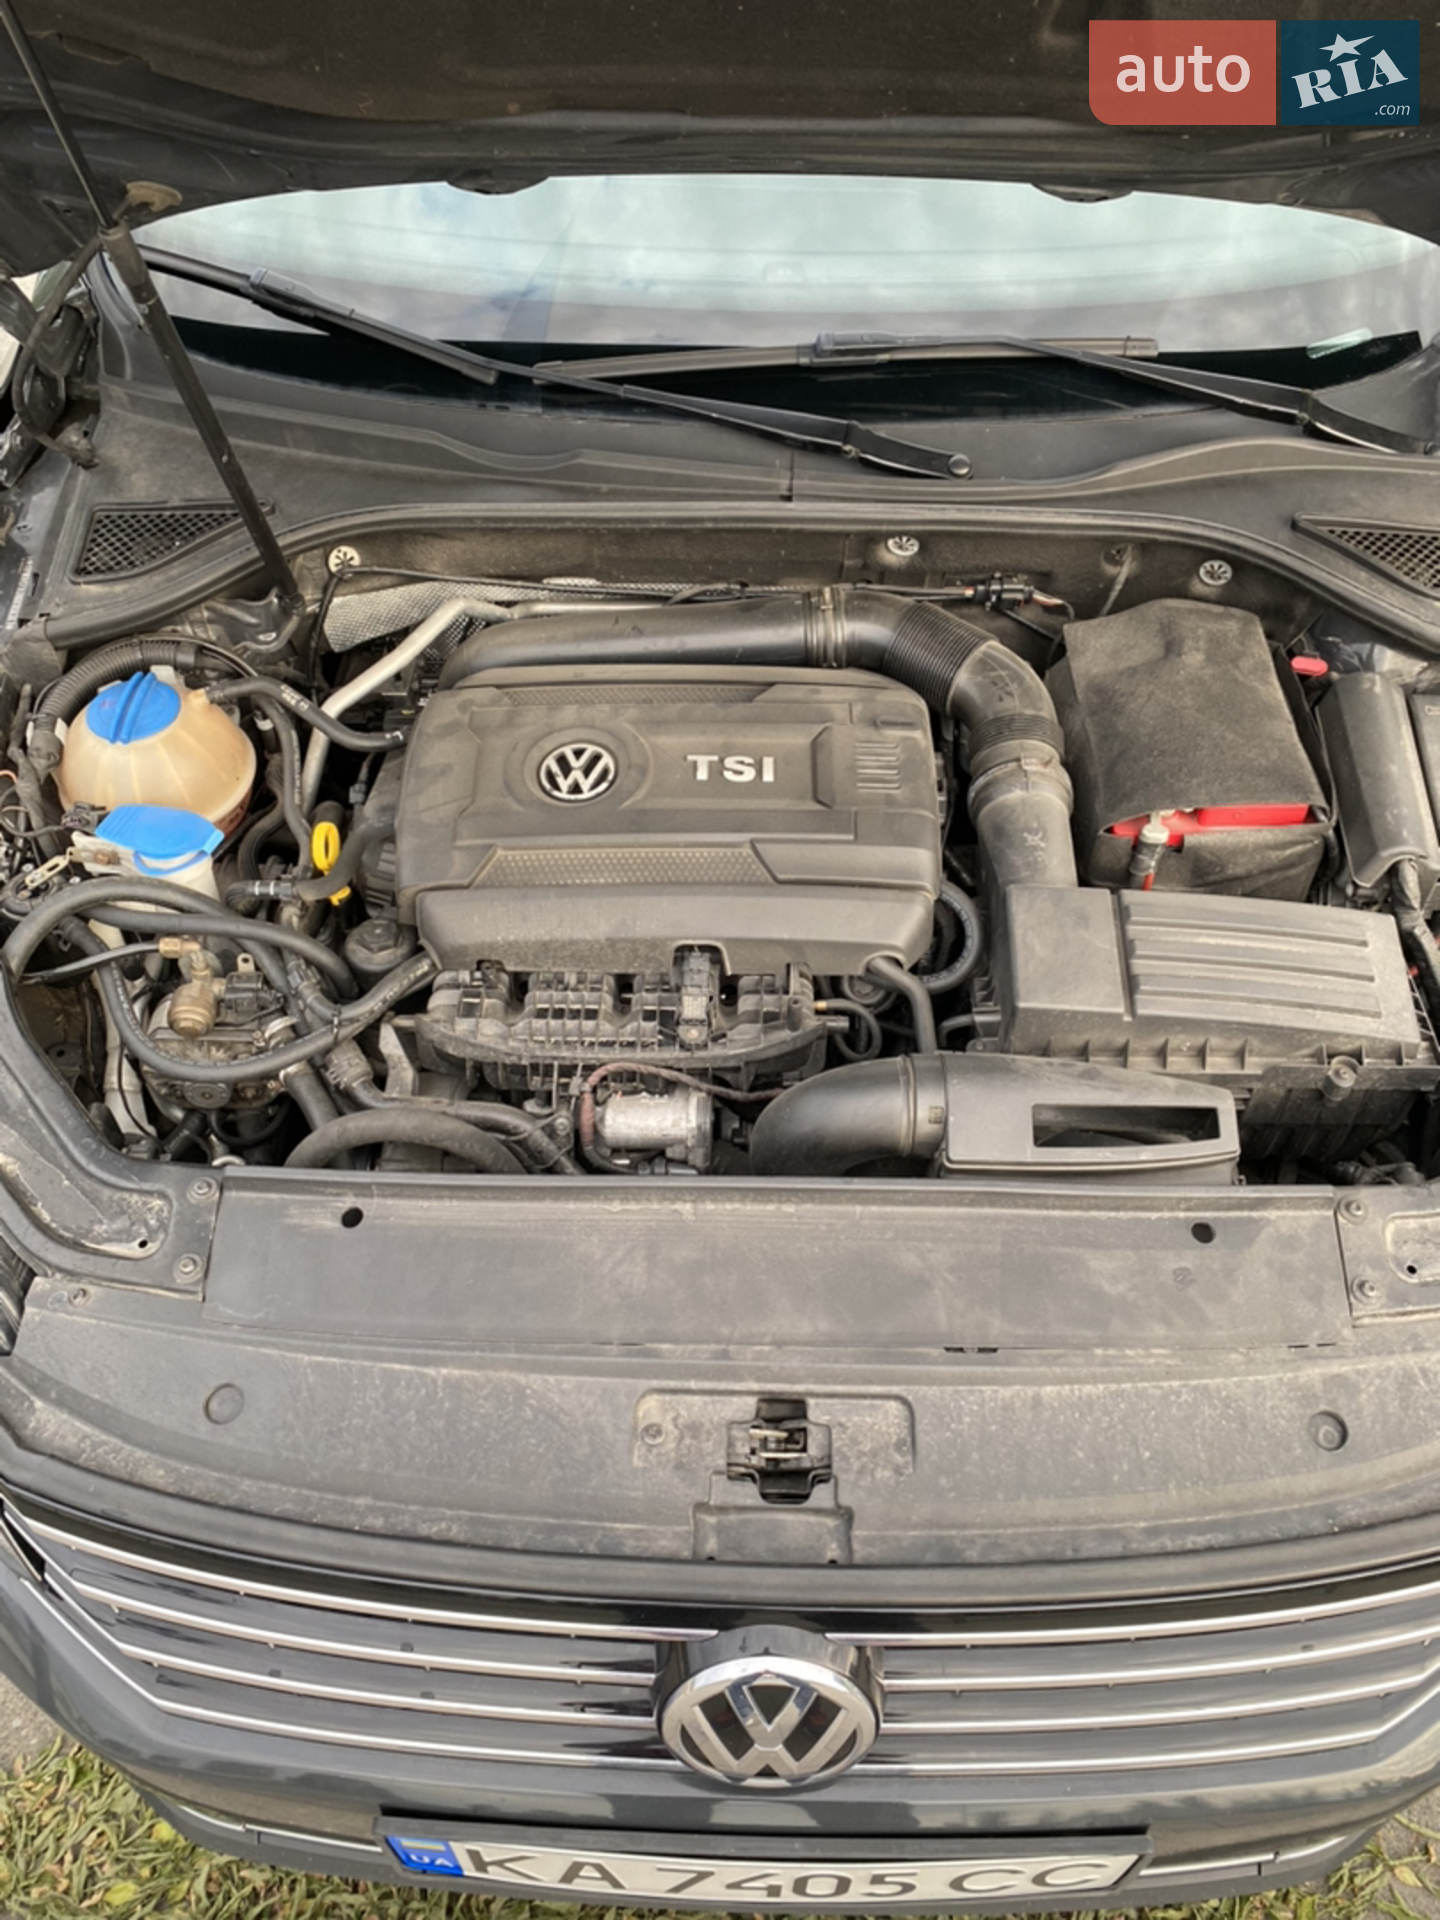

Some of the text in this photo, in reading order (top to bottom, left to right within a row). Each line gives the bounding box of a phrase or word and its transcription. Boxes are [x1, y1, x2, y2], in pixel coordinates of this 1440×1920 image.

[686, 754, 775, 783] TSI
[409, 1853, 455, 1868] UA
[466, 1848, 1110, 1898] KA 7405 CC
